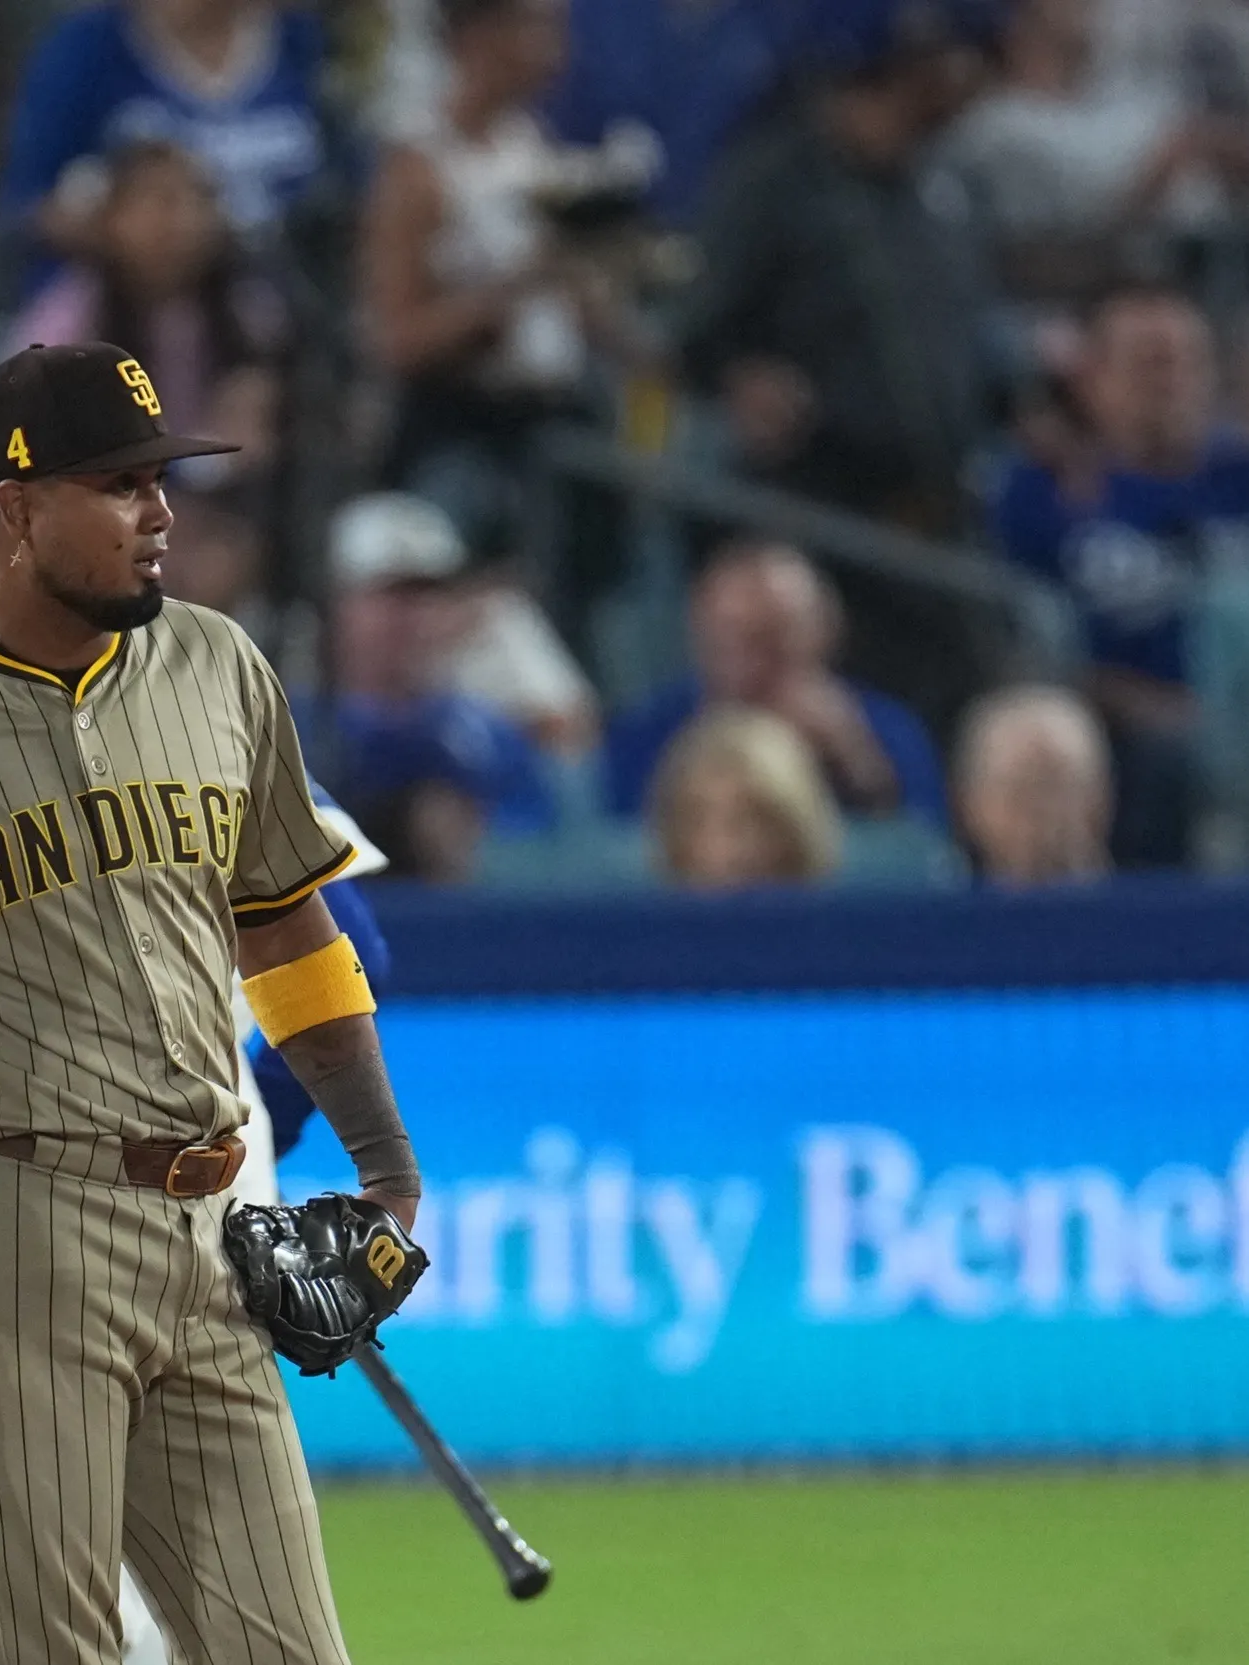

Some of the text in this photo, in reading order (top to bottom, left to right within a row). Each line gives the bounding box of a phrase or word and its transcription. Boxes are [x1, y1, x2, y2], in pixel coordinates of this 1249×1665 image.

[116, 359, 162, 416] SD
[7, 427, 32, 469] 4
[76, 781, 246, 880] DIEGO
[798, 1124, 1249, 1318] Bene
